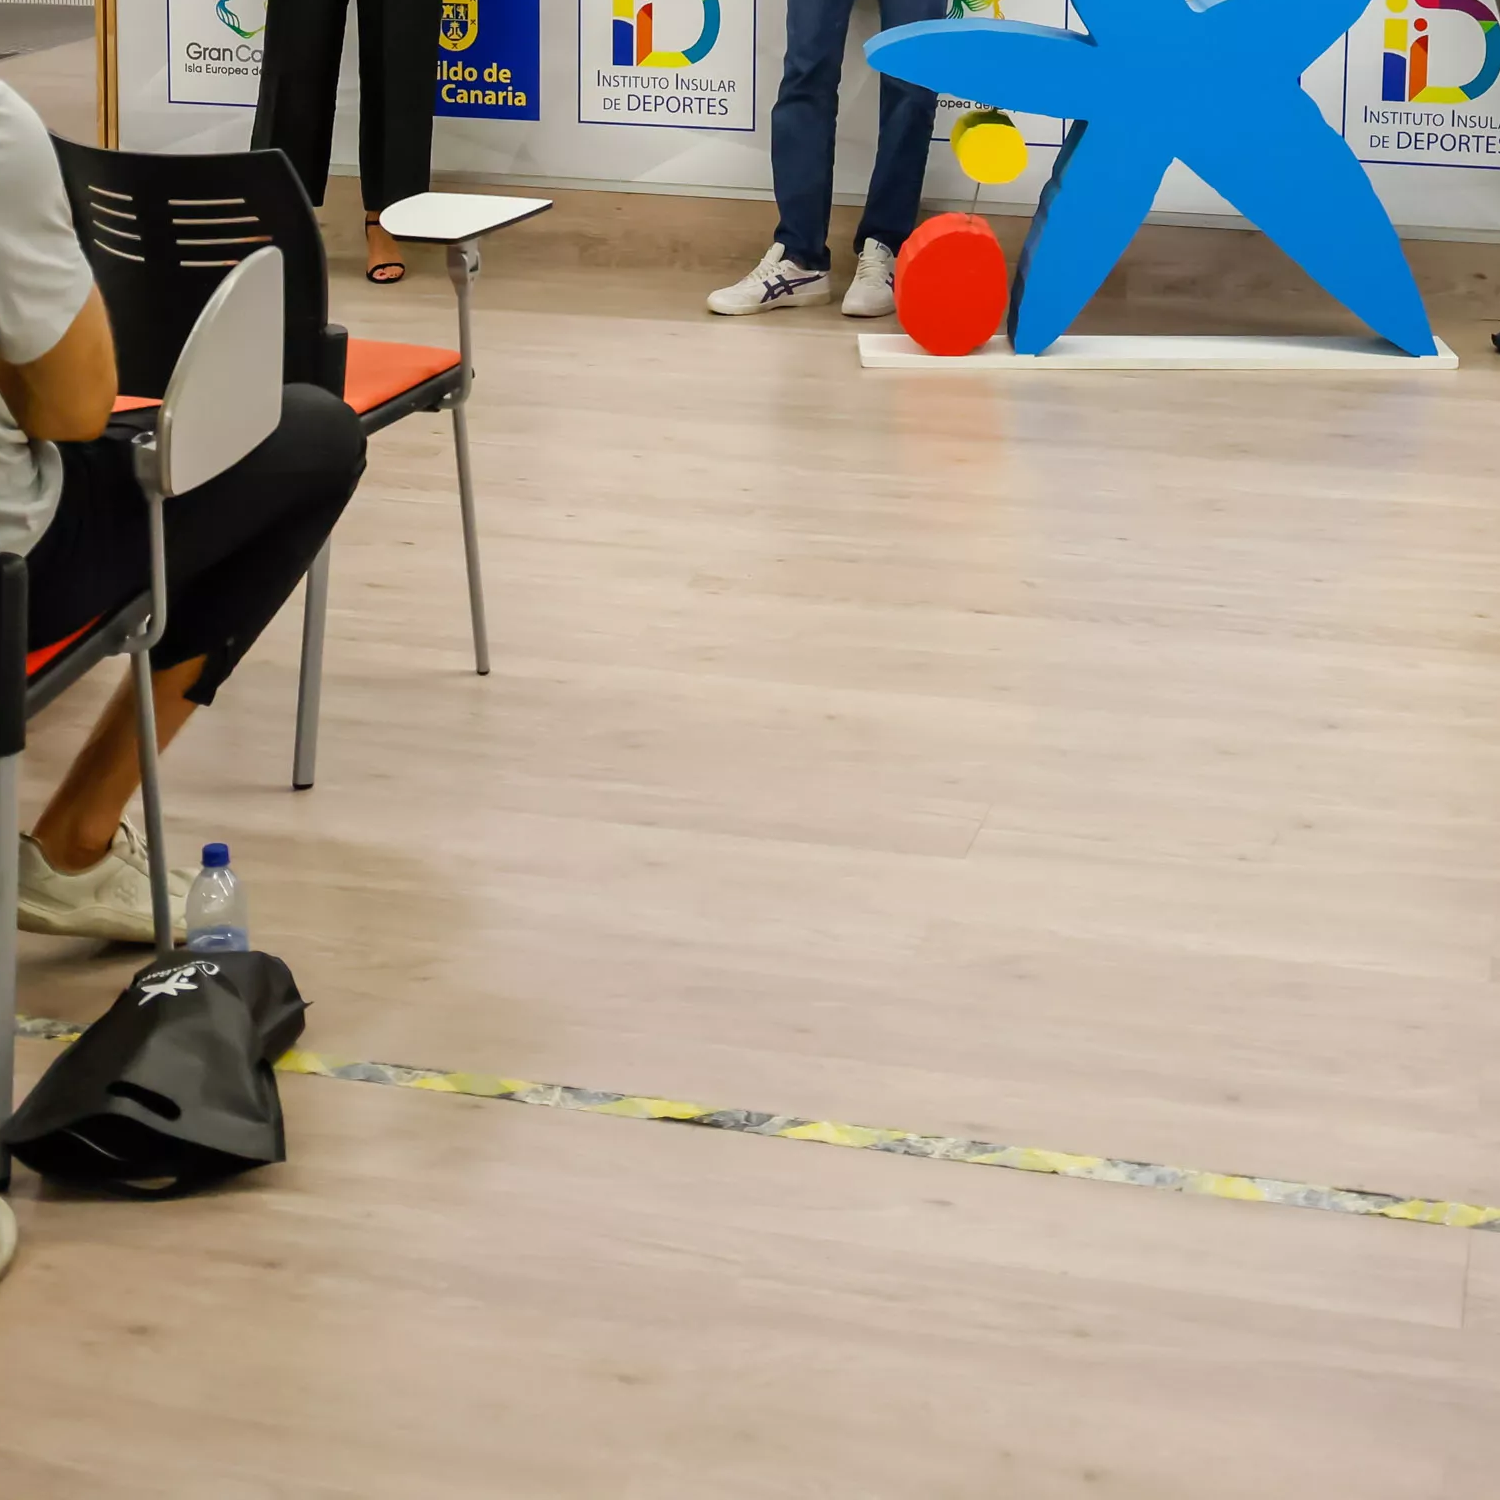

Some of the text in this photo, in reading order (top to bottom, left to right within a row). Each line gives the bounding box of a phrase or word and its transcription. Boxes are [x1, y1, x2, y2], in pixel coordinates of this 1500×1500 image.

[186, 42, 233, 62] Gran
[184, 63, 202, 73] Isla
[205, 64, 249, 76] Europea
[436, 60, 512, 84] ildo de
[441, 83, 527, 107] Canaria
[603, 94, 729, 116] DE DEPORTES
[1370, 135, 1390, 149] DE
